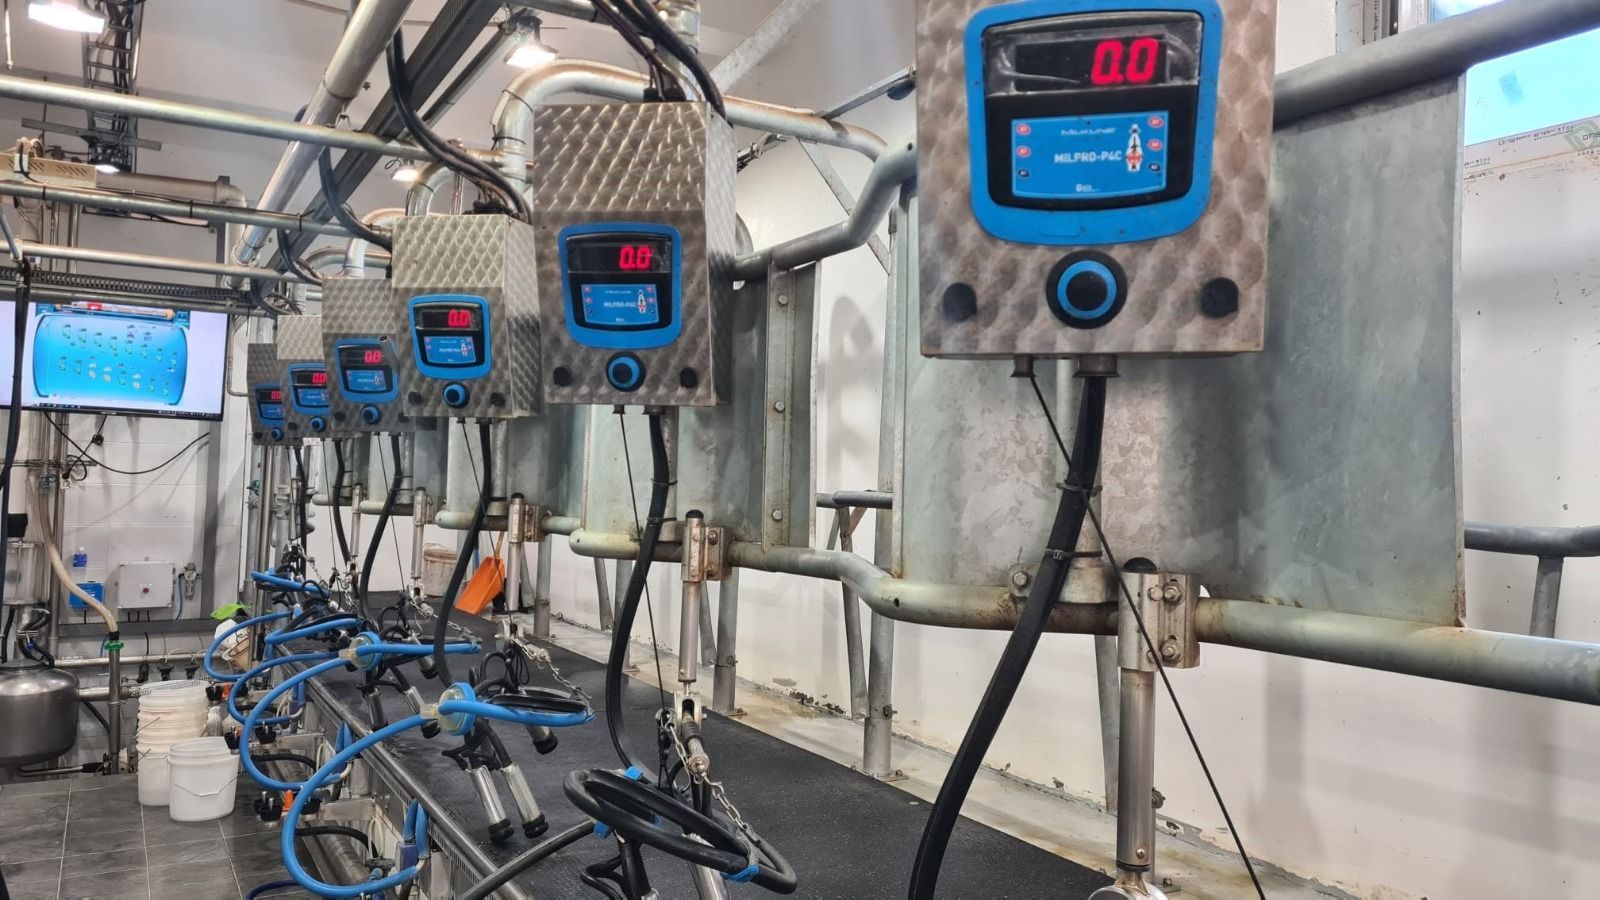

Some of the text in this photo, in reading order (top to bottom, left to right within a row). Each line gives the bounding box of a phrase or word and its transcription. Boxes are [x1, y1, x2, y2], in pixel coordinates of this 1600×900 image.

[1091, 38, 1159, 84] 0.0
[1055, 150, 1122, 162] MILPRO-P4C
[618, 245, 652, 270] 0.0
